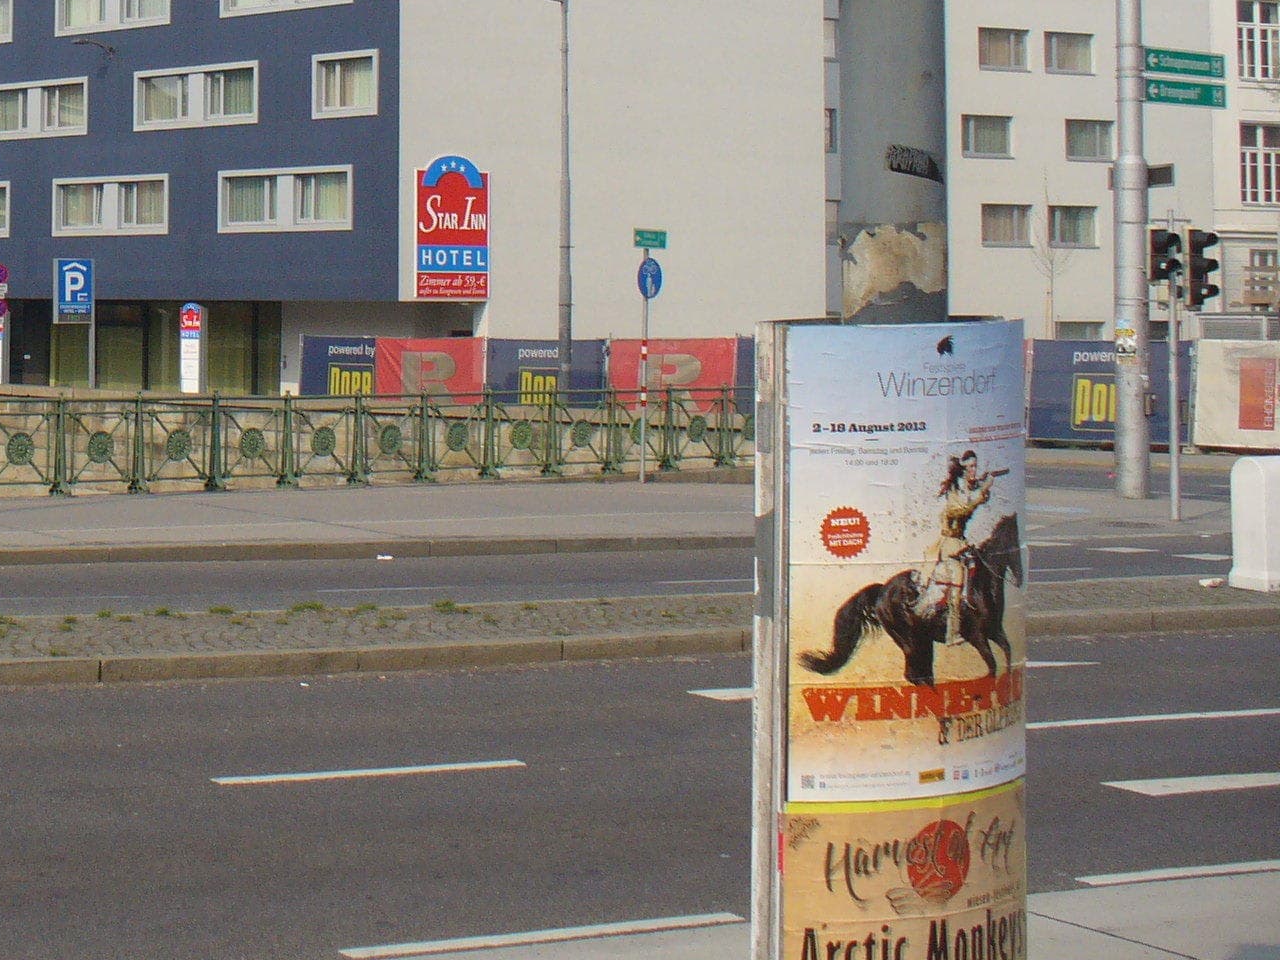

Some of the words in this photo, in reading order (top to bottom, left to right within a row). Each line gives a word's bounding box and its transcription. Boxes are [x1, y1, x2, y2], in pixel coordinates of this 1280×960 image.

[419, 195, 459, 233] STAR
[460, 196, 486, 230] INN
[422, 249, 486, 266] HOTEL
[65, 271, 84, 301] P
[419, 275, 451, 287] Zimmer
[452, 275, 463, 286] ab
[328, 344, 363, 356] powered
[365, 344, 376, 358] by
[518, 346, 559, 359] powered
[877, 367, 999, 397] Winzendorf
[848, 421, 894, 434] August
[897, 421, 927, 433] 2013
[831, 518, 860, 526] NEU!
